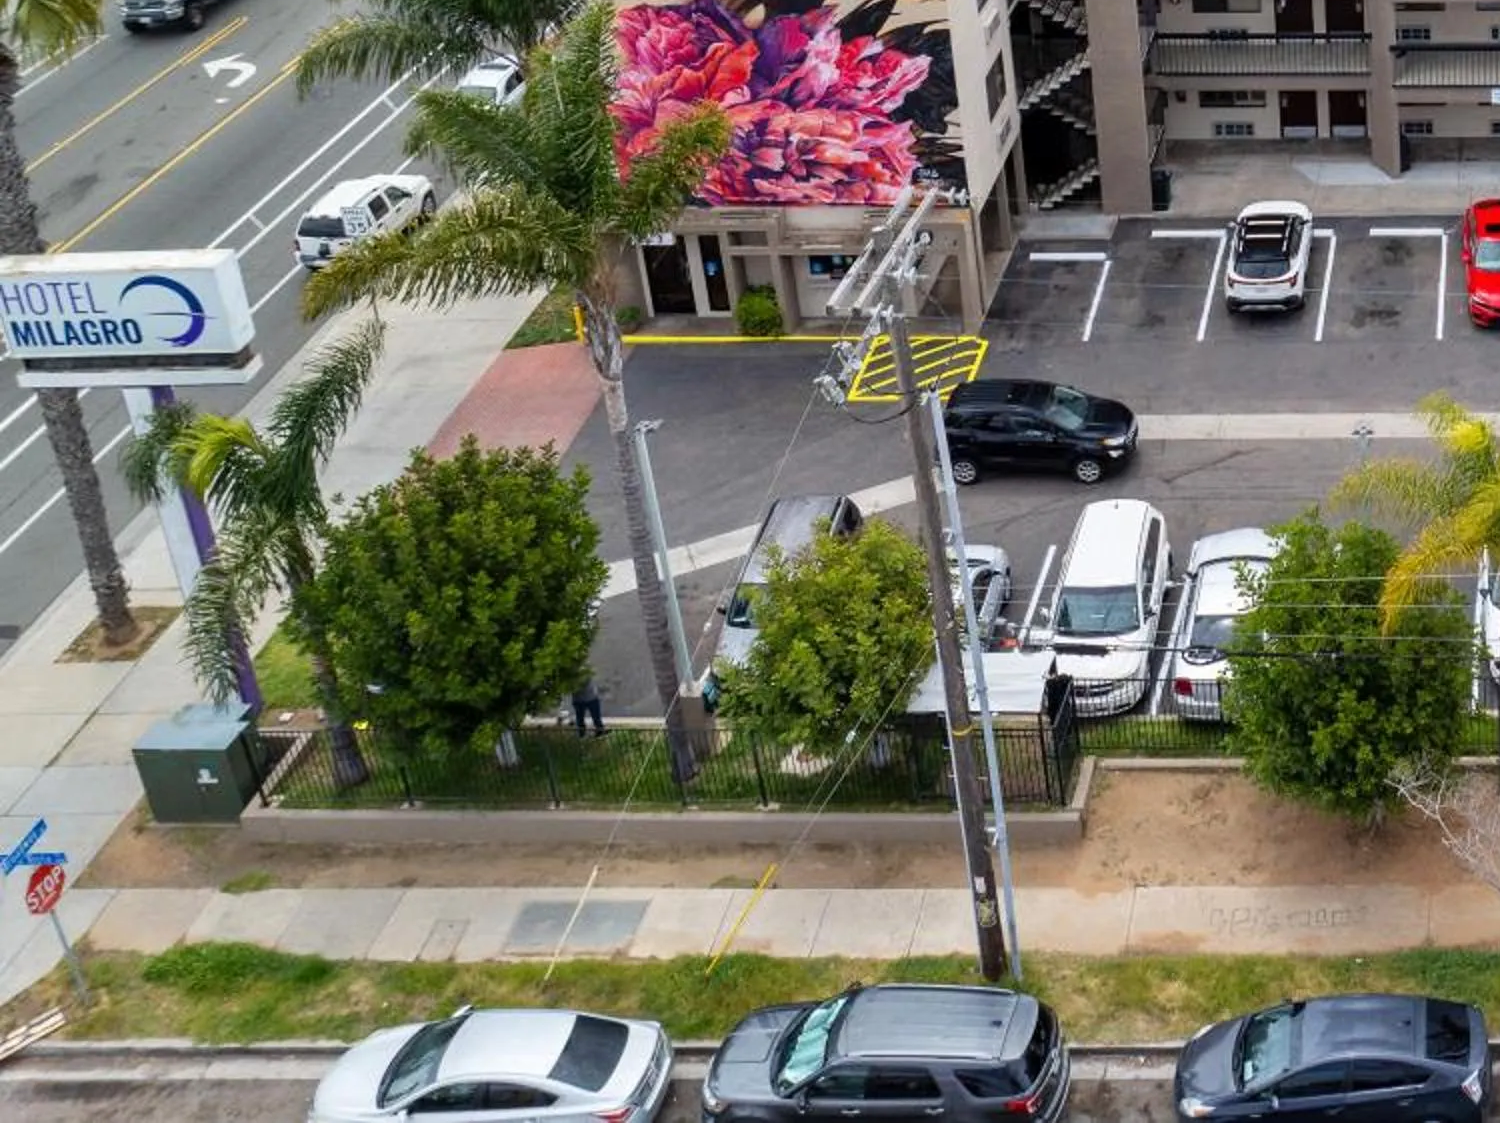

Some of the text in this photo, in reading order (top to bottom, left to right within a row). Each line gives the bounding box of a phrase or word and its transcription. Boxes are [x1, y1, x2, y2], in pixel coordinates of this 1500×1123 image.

[347, 222, 367, 234] 35
[0, 281, 107, 316] HOTEL
[9, 318, 144, 347] MILAGRO
[27, 866, 62, 911] STOP
